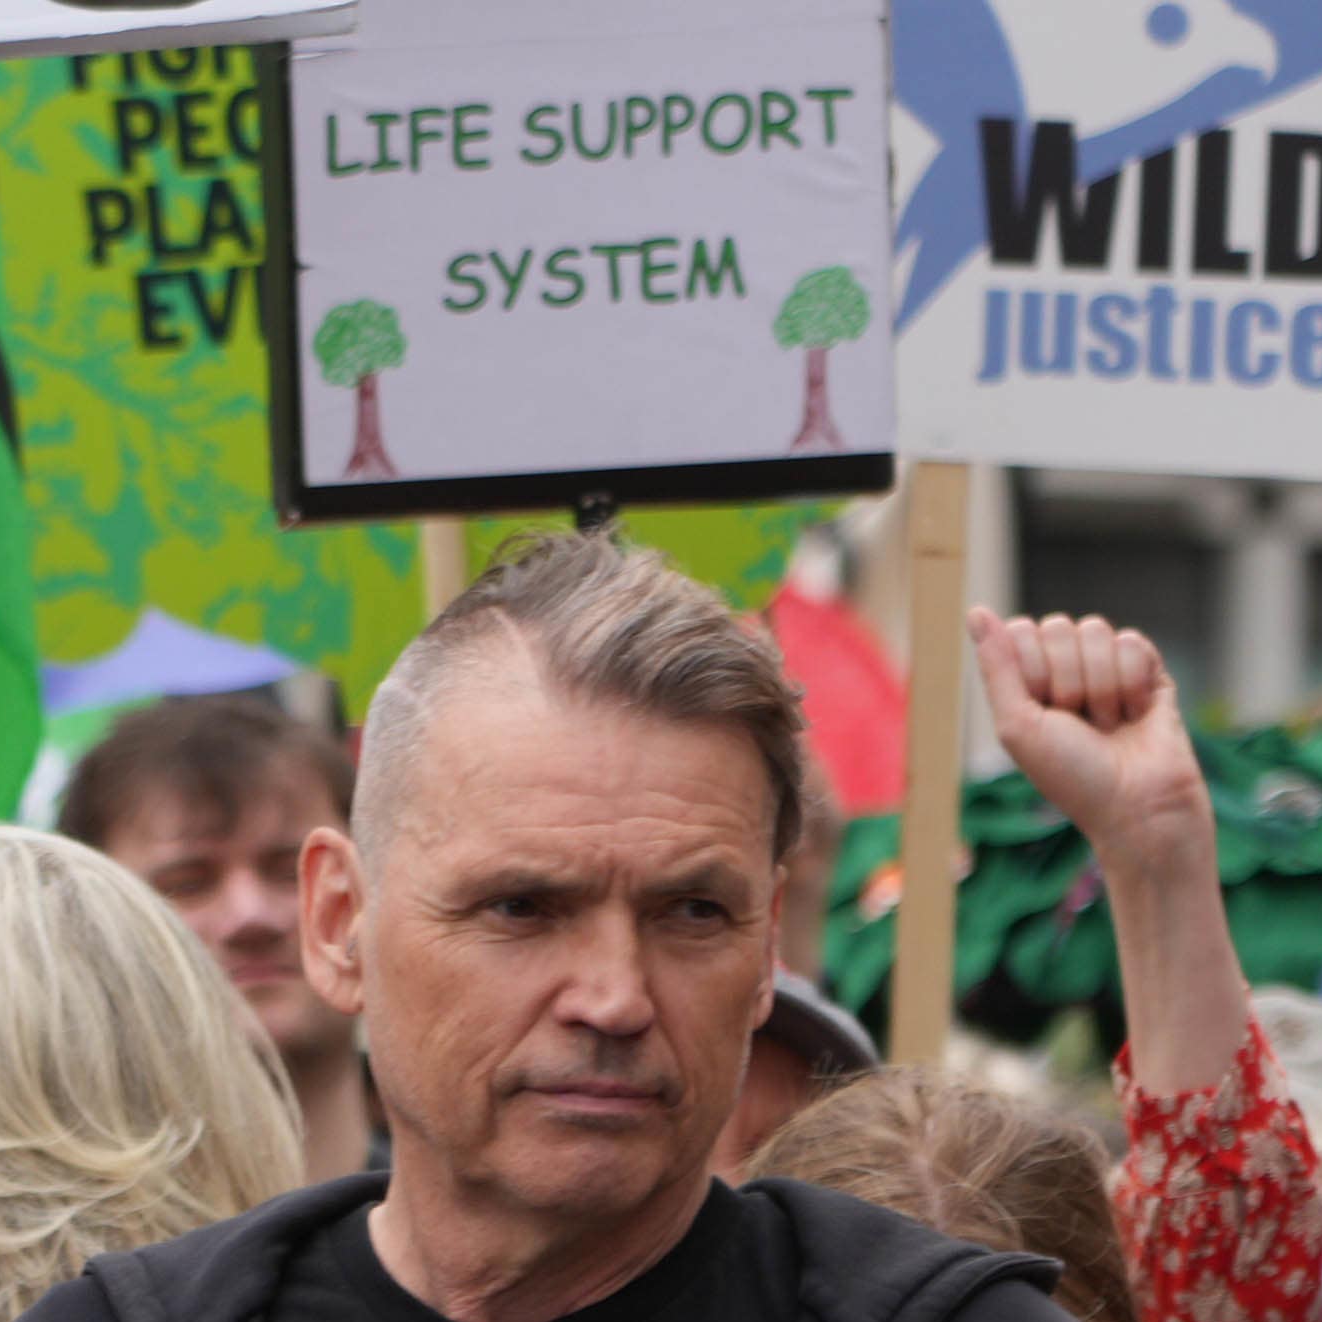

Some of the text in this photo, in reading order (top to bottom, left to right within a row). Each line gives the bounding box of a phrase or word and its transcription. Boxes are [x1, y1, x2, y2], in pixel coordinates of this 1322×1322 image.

[326, 87, 855, 178] LIFE SUPPORT
[136, 265, 268, 349] EV
[442, 236, 747, 313] SYSTEM
